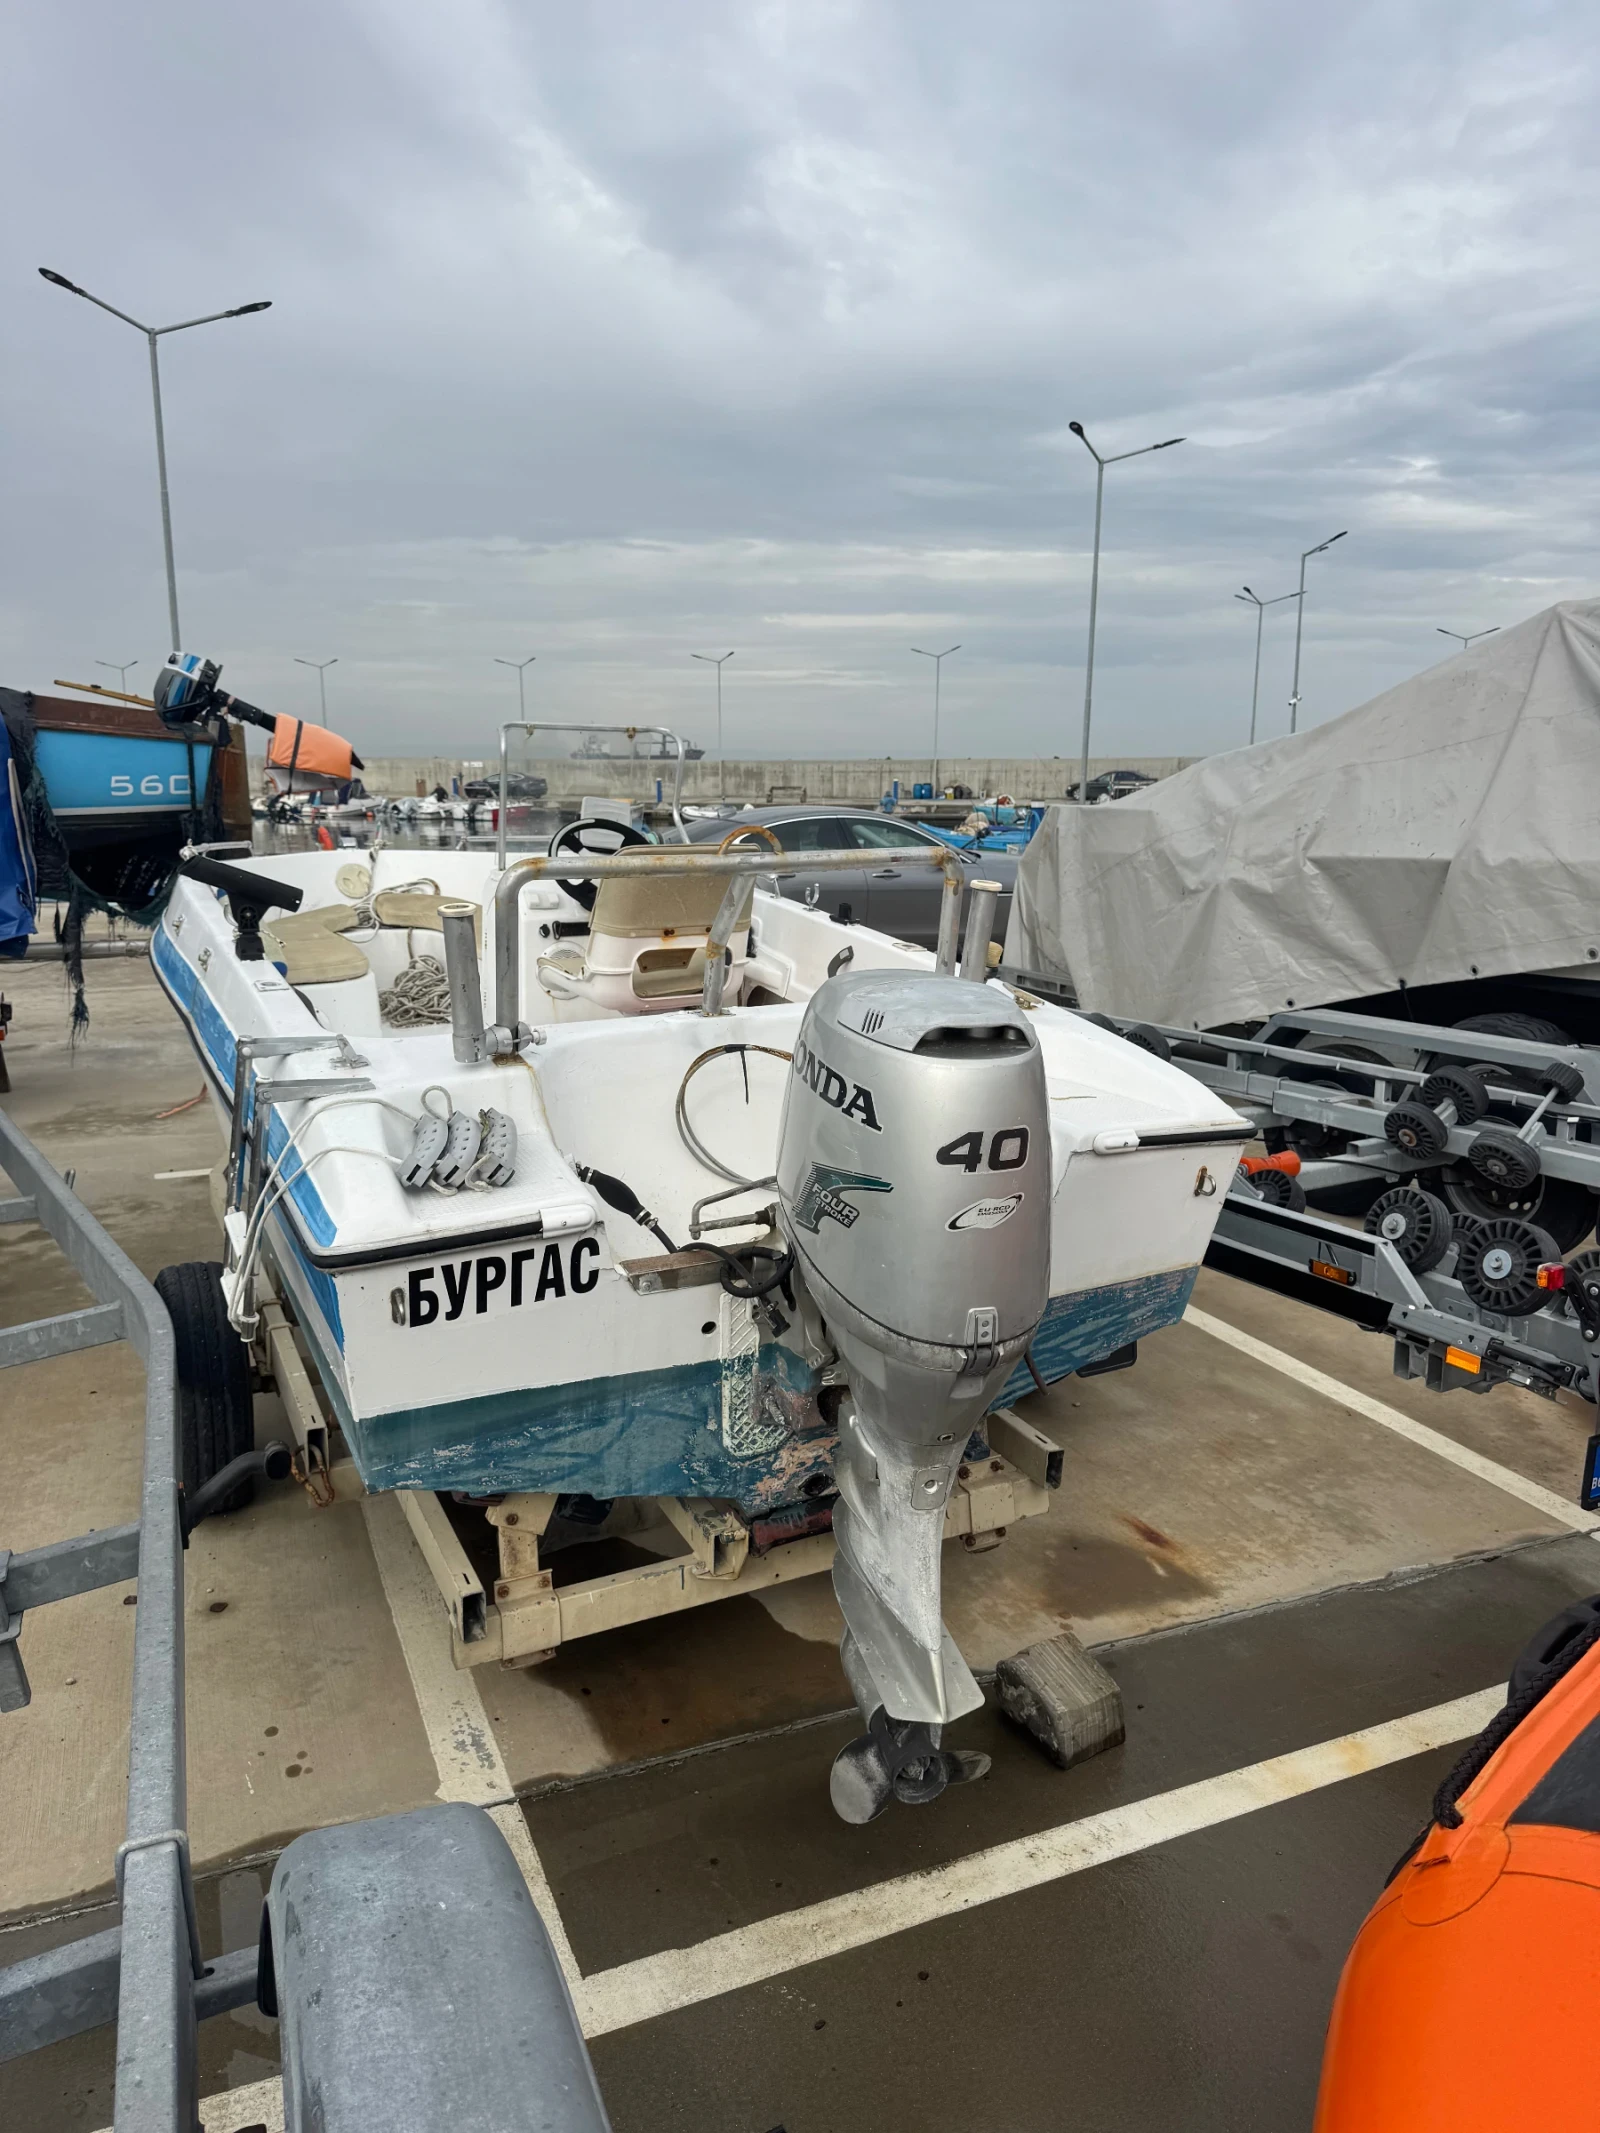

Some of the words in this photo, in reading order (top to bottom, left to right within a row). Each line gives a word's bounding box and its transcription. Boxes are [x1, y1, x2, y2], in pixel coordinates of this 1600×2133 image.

[110, 774, 191, 797] 560
[795, 1040, 882, 1132] ONDA
[936, 1127, 1029, 1173] 40
[812, 1183, 859, 1221] FOUR
[815, 1197, 852, 1227] STROKE
[408, 1237, 601, 1328] БУРГАС
